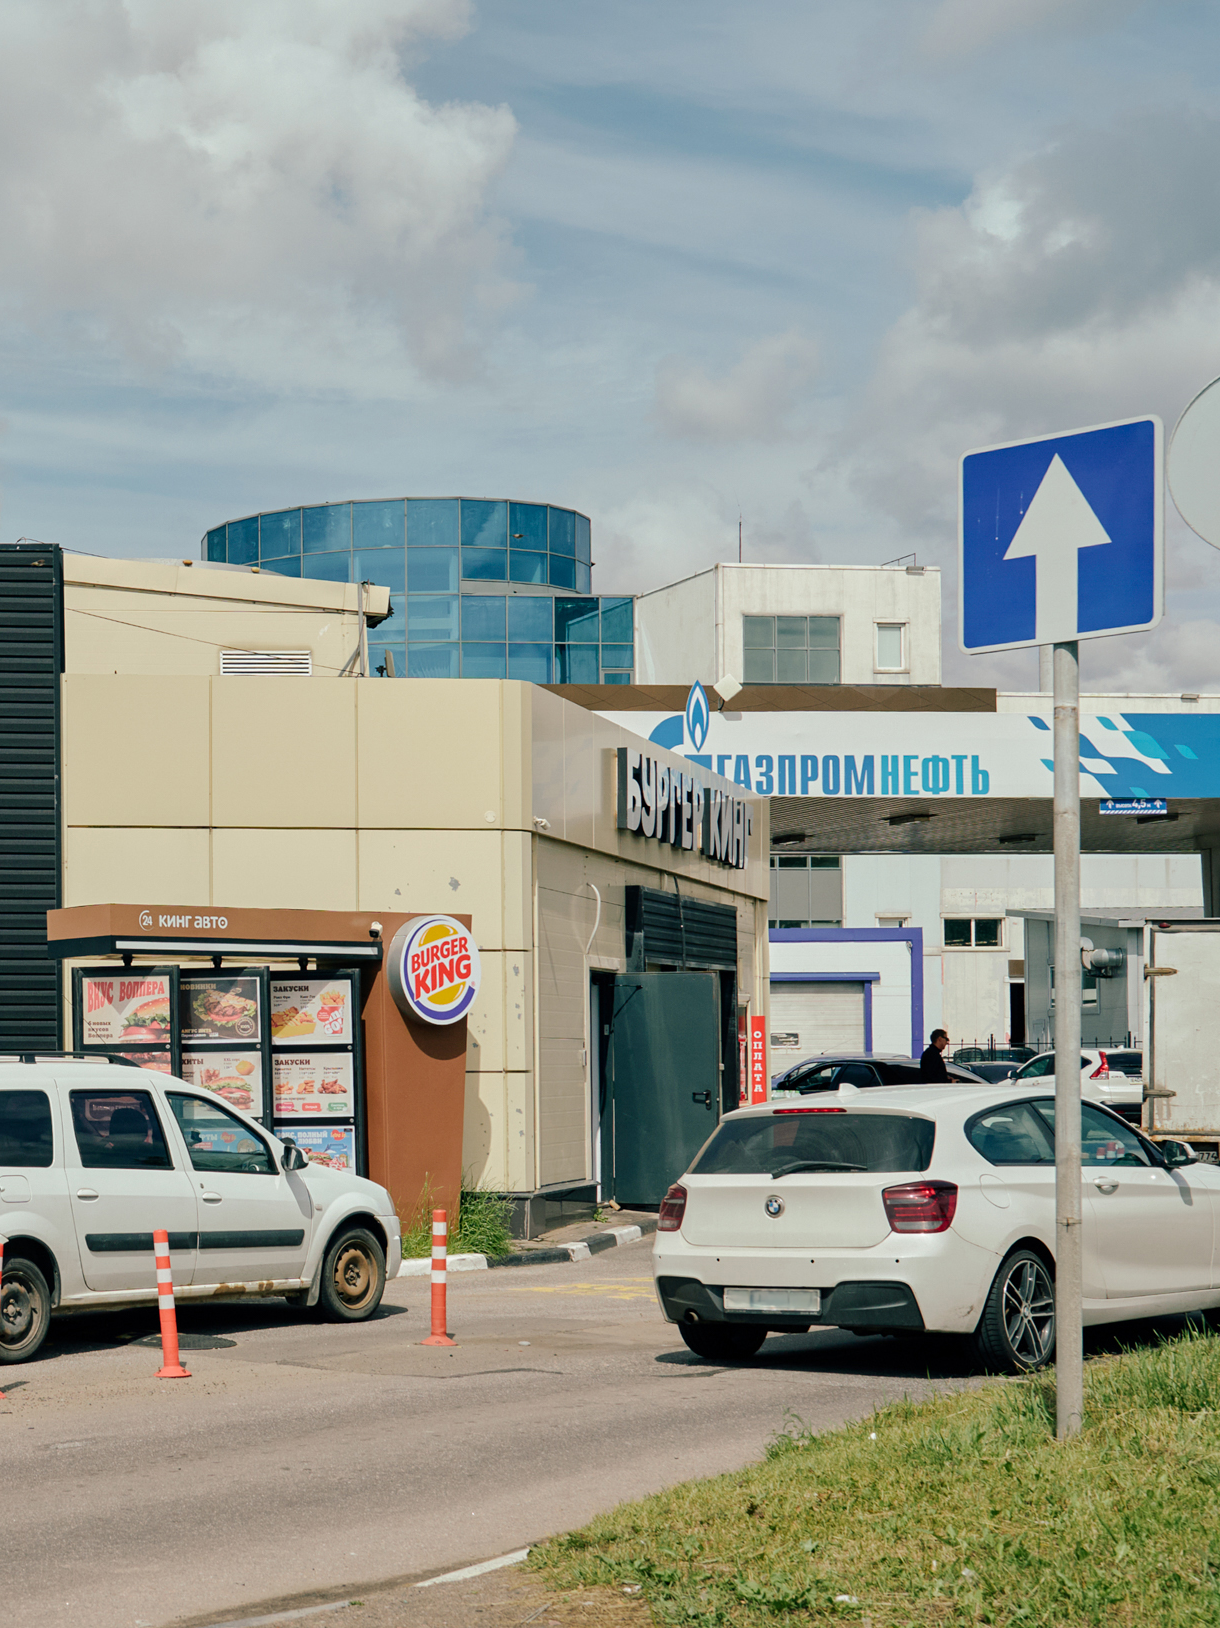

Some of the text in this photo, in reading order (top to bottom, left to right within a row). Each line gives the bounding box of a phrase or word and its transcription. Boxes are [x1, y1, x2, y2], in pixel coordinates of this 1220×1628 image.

[716, 754, 990, 796] ГАЗПРОМНЕФТЬ
[625, 747, 754, 870] БУРГЕР КИНГ
[142, 915, 153, 926] 24
[411, 936, 469, 974] BURGER
[180, 983, 216, 991] НОВИНКИ
[414, 953, 472, 1000] KING
[87, 981, 165, 1013] ВКУС ВОППЕРА
[753, 1031, 763, 1092] ОПЛАТА
[297, 1130, 328, 1138] ПОЛНЫЙ
